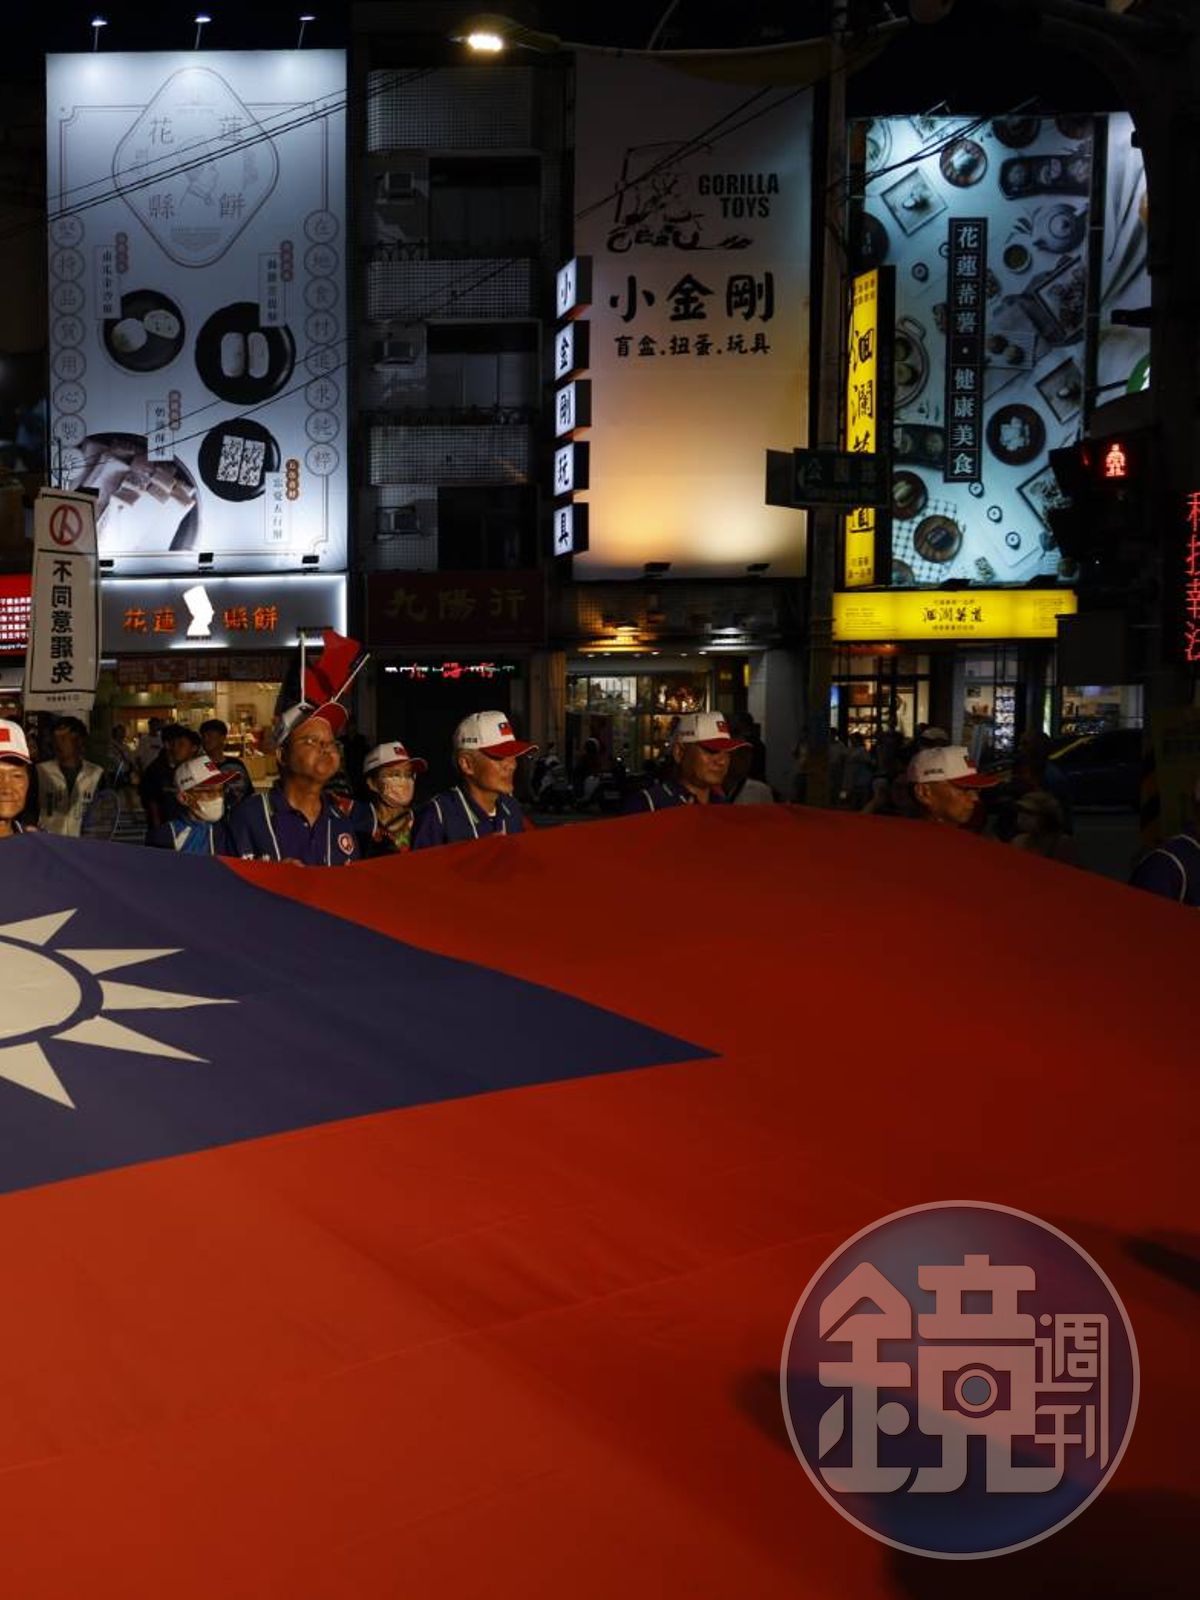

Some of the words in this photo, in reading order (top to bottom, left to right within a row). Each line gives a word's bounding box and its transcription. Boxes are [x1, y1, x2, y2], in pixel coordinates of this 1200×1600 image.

[699, 173, 779, 196] GORILLA
[720, 197, 770, 218] TOYS
[609, 272, 775, 322] 小金剛
[122, 606, 177, 633] 花蓮
[223, 605, 278, 632] 縣餅
